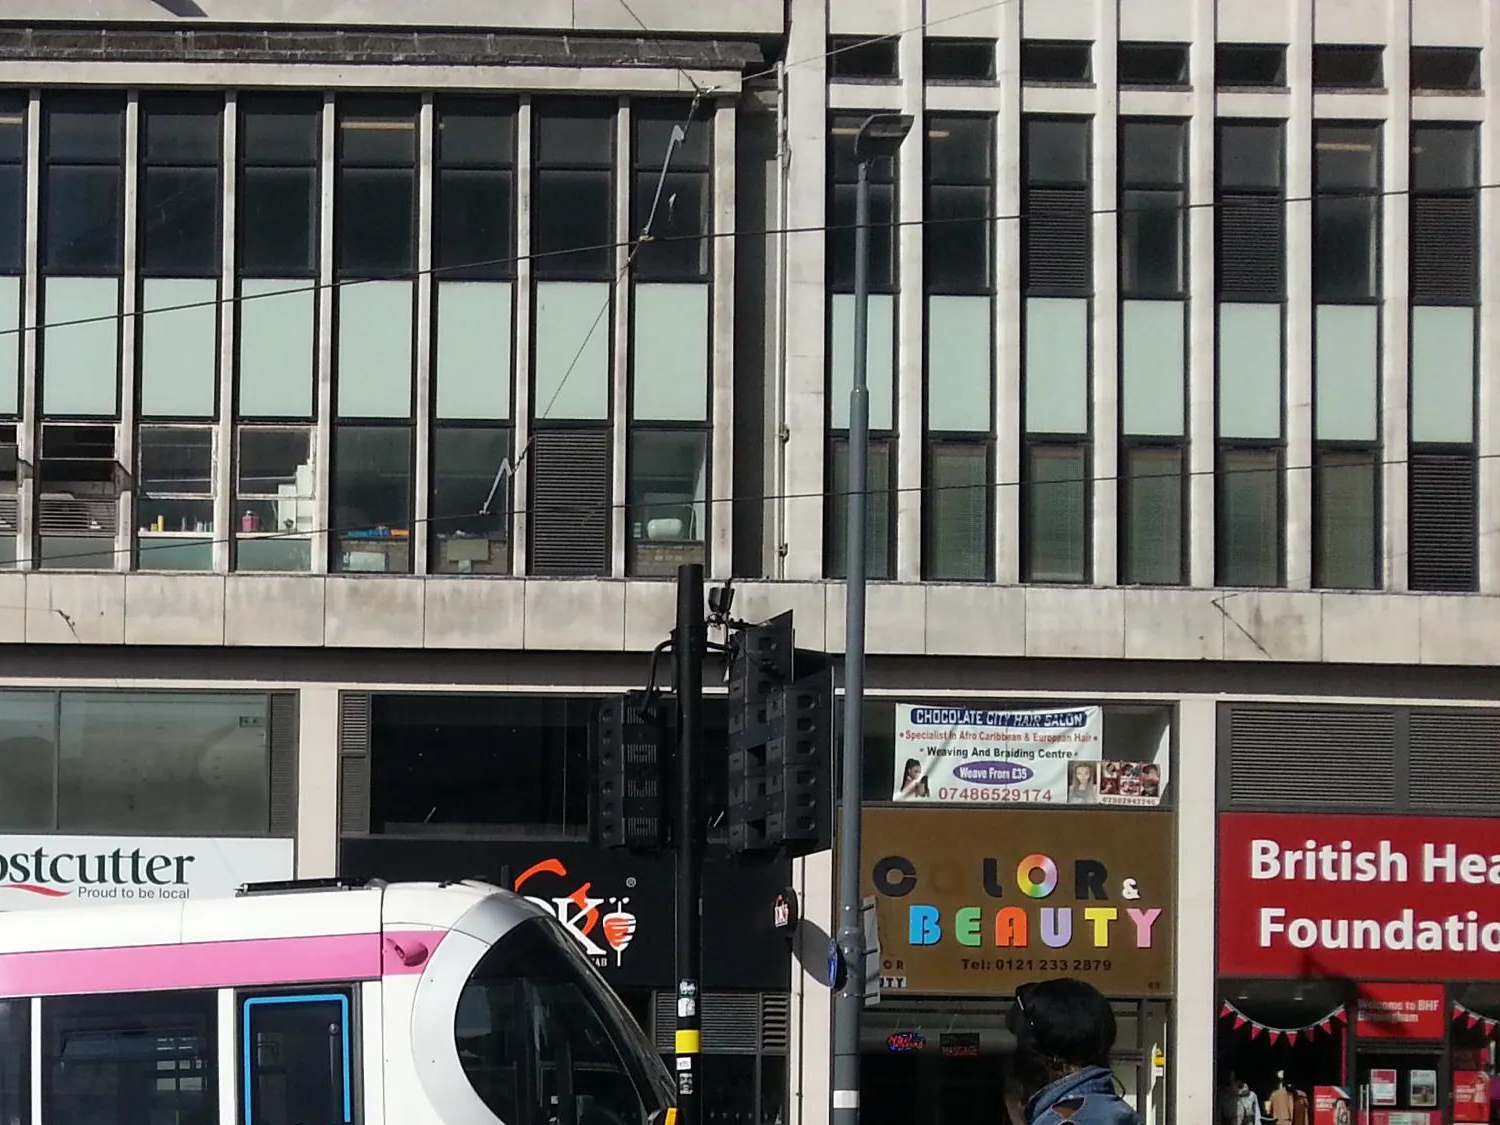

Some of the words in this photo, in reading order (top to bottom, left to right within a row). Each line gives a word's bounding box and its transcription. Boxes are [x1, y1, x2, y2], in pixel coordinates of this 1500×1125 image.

[915, 709, 983, 725] CHOCOLATE
[986, 711, 1009, 726] CITY
[1012, 713, 1041, 727] HAIR
[1043, 713, 1083, 727] SALON
[905, 729, 947, 741] Specialist
[959, 730, 977, 741] Afro
[979, 731, 1022, 742] Caribbean
[1033, 733, 1072, 744] European
[1074, 733, 1092, 743] Hair
[926, 746, 968, 759] Weaving
[971, 748, 991, 758] And
[993, 748, 1035, 760] Braiding
[1038, 749, 1073, 759] Centre
[959, 766, 987, 779] Weave
[989, 767, 1010, 779] From
[938, 787, 1052, 801] 07486529174
[1251, 839, 1408, 882] British
[78, 886, 117, 898] Proud
[120, 888, 135, 898] to
[138, 887, 155, 899] be
[158, 888, 190, 899] local
[1122, 878, 1140, 900] &
[908, 904, 1162, 948] BEAUTY
[1260, 907, 1500, 952] Foundatio
[961, 958, 991, 971] Tel:
[995, 959, 1033, 971] 0121
[1039, 959, 1068, 971] 233
[1073, 959, 1112, 971] 2879
